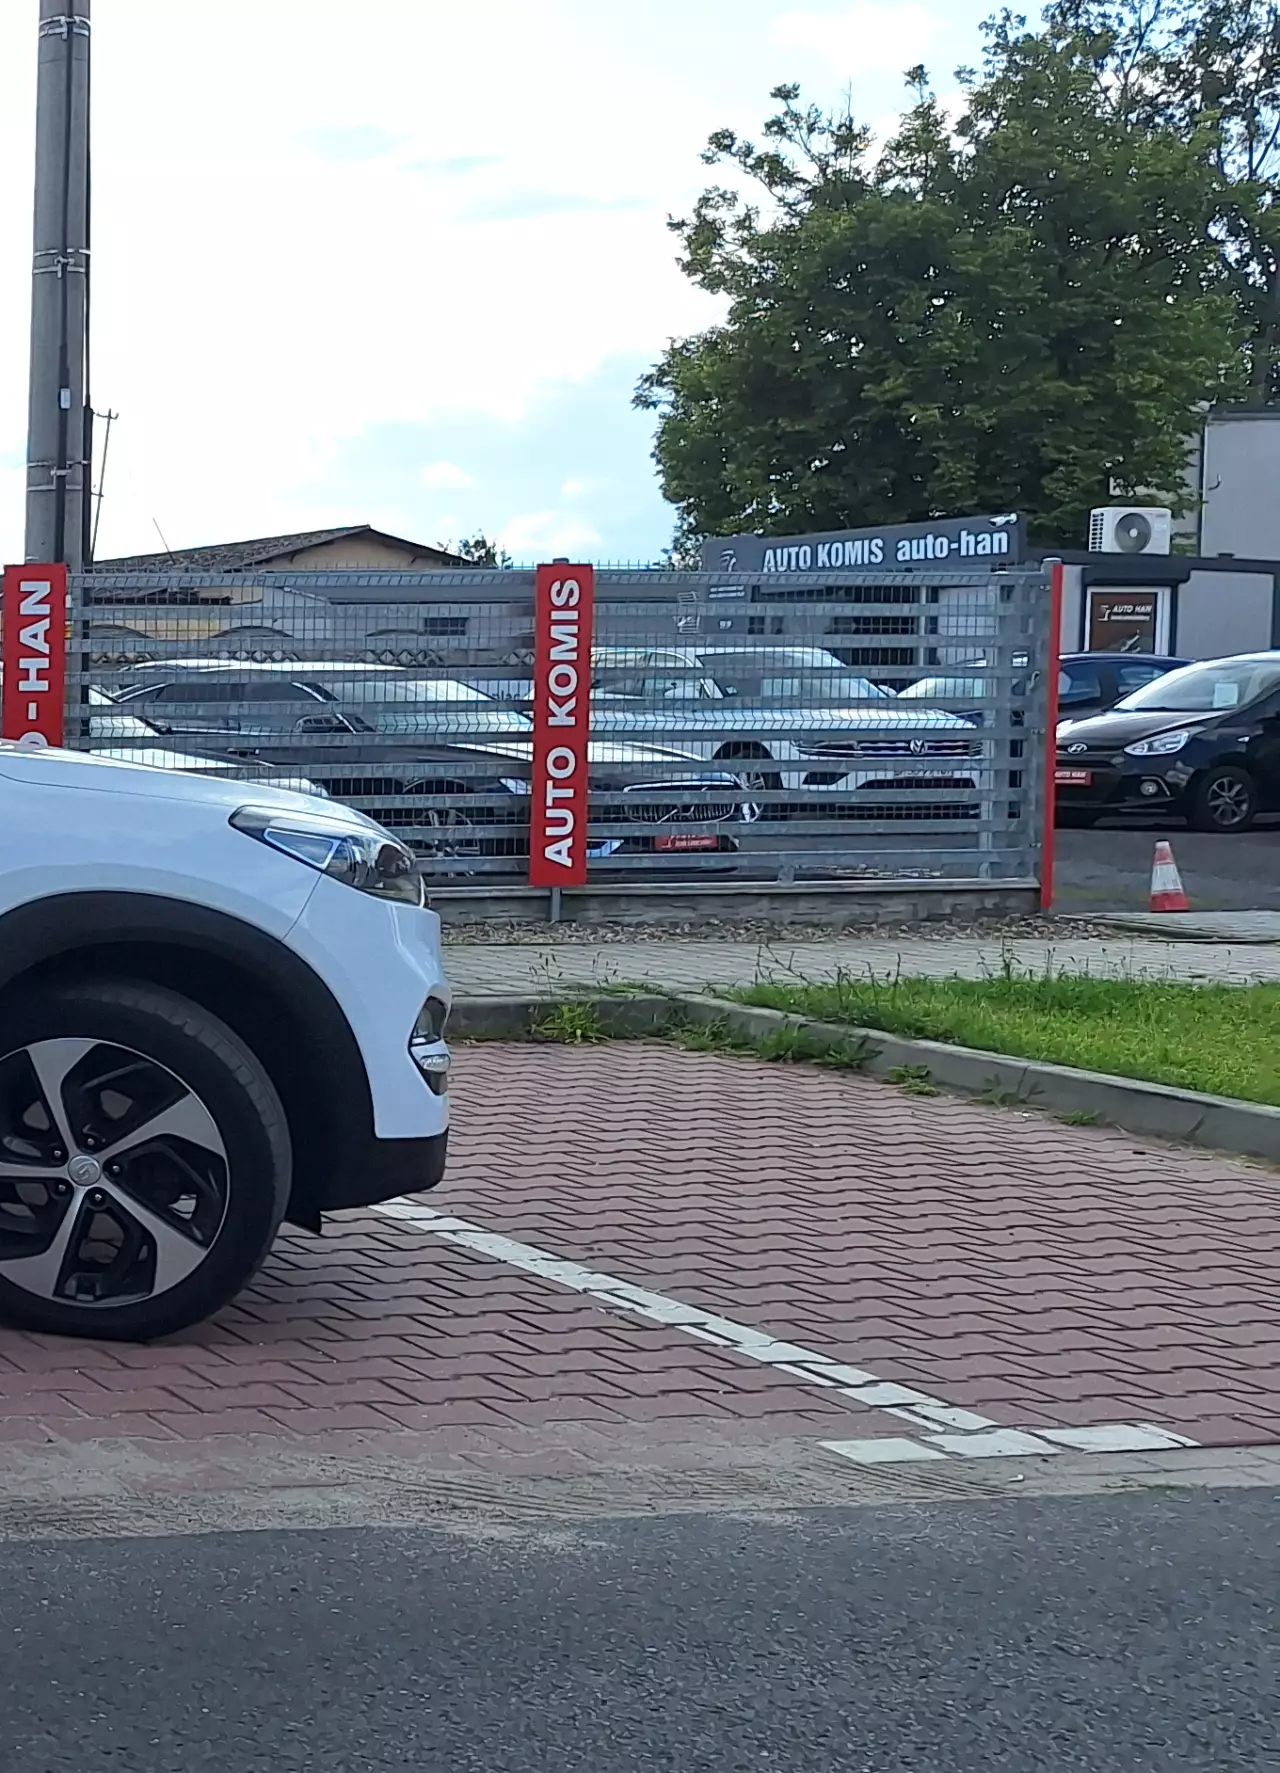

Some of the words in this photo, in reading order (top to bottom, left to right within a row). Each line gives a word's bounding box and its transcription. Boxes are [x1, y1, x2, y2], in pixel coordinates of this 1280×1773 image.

[763, 545, 811, 573] AUTO
[817, 538, 883, 568] KOMIS
[896, 530, 1008, 562] auto-han
[548, 579, 580, 726] KOMIS
[544, 746, 576, 867] AUTO
